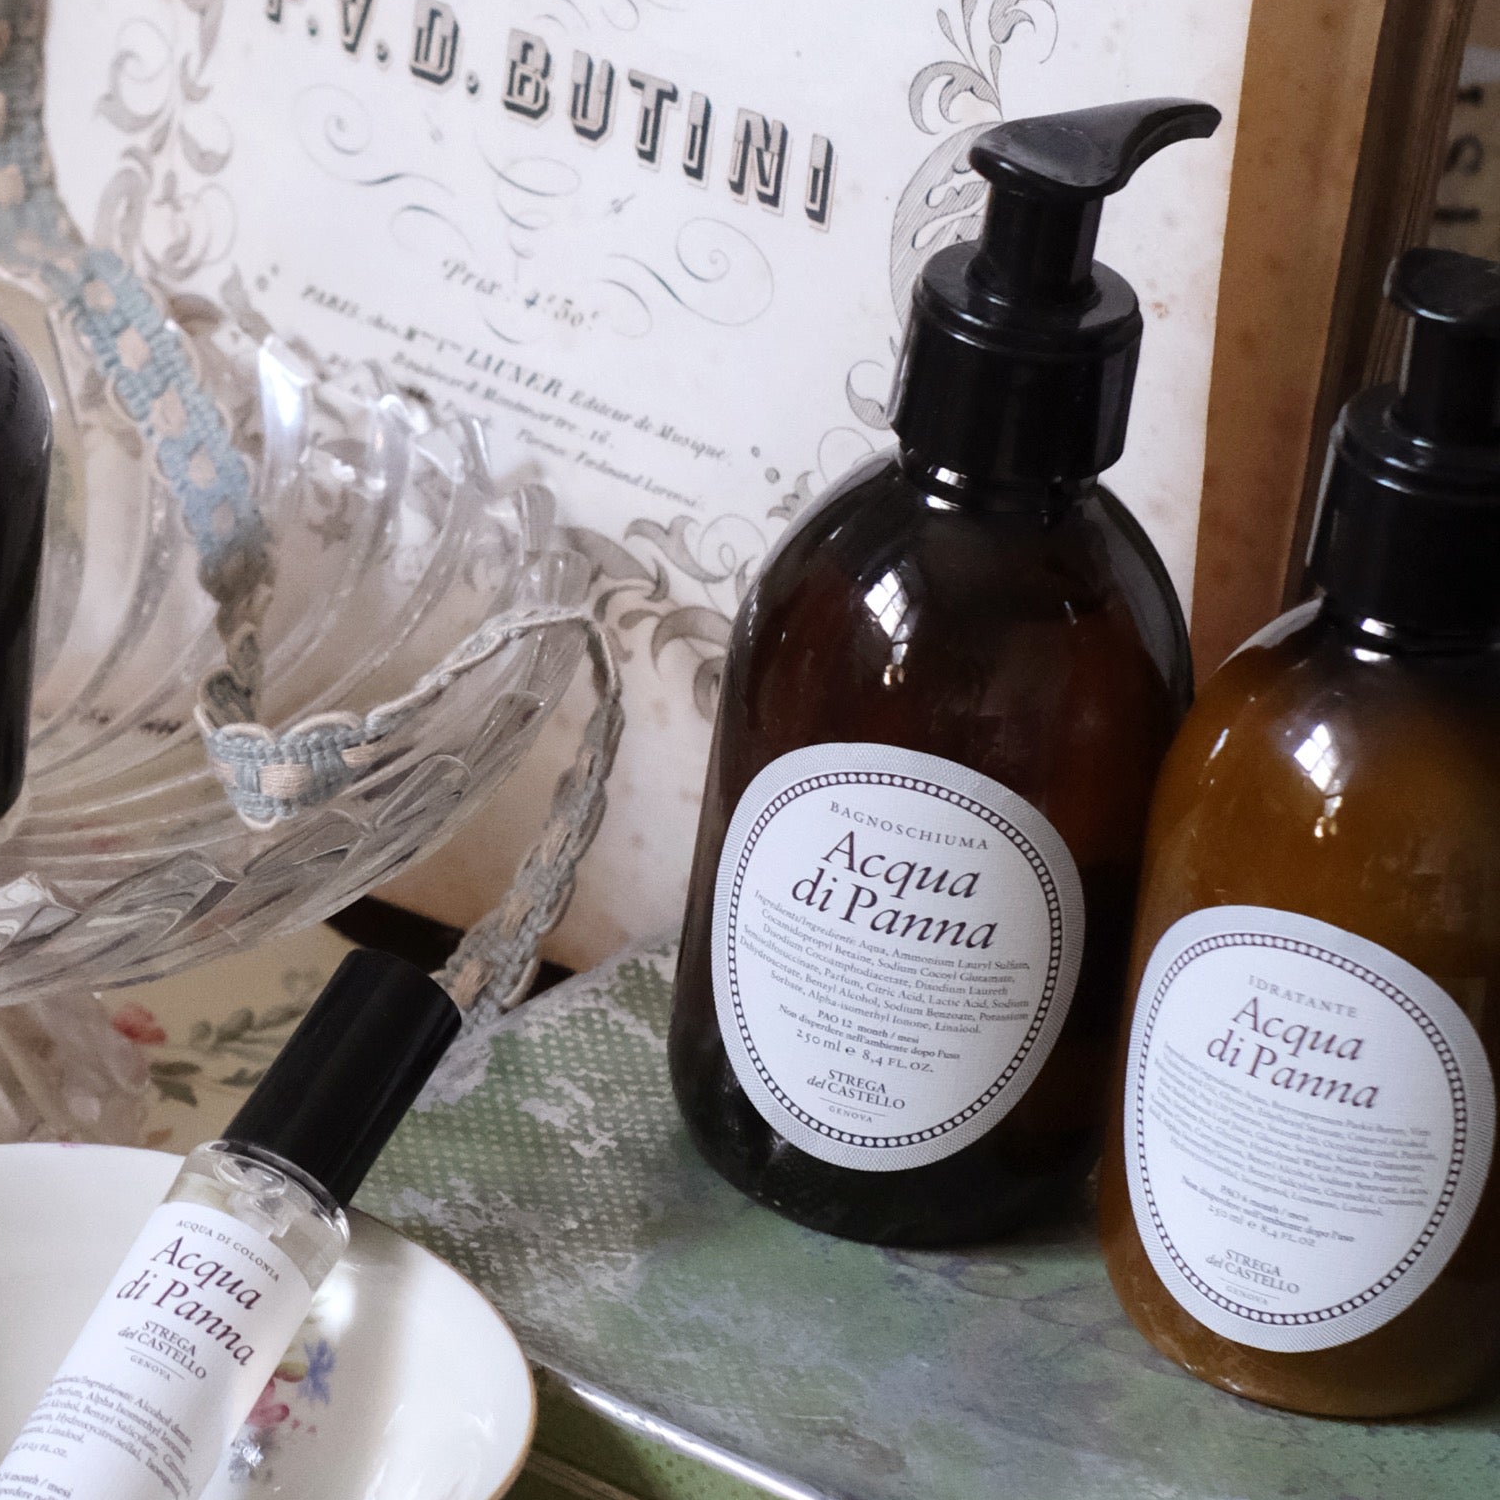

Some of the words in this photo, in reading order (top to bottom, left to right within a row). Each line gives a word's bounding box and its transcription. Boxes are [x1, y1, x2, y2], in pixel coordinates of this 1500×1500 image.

[502, 27, 837, 234] BUTINI
[829, 801, 989, 851] BAGNOSCHIUMA
[821, 830, 982, 899] Acqua
[791, 867, 838, 913] di
[839, 884, 1000, 950] Panna
[877, 959, 916, 974] Sodium
[958, 959, 991, 970] Lauryl
[817, 1010, 839, 1024] PAO
[1248, 974, 1359, 1019] IDRATANTE
[797, 1029, 820, 1045] 250
[823, 1037, 841, 1052] ml
[1232, 996, 1365, 1062] Acqua
[829, 1069, 886, 1093] STREGA
[1207, 1029, 1242, 1068] di
[1245, 1044, 1381, 1109] Panna
[807, 1076, 826, 1089] del
[828, 1081, 905, 1110] CASTELLO
[829, 1106, 872, 1123] GENOVA
[176, 1220, 212, 1237] ACQUA
[217, 1232, 230, 1245] DI
[233, 1242, 280, 1282] COLONIA
[1226, 1249, 1281, 1276] STREGA
[150, 1236, 262, 1310] Acqua
[1206, 1255, 1223, 1268] del
[1225, 1262, 1299, 1294] CASTELLO
[116, 1270, 158, 1300] di
[152, 1278, 254, 1366] Panna
[143, 1320, 196, 1356] STREGA
[118, 1327, 138, 1339] del
[138, 1333, 207, 1379] CASTELLO
[130, 1355, 172, 1381] GENOVA
